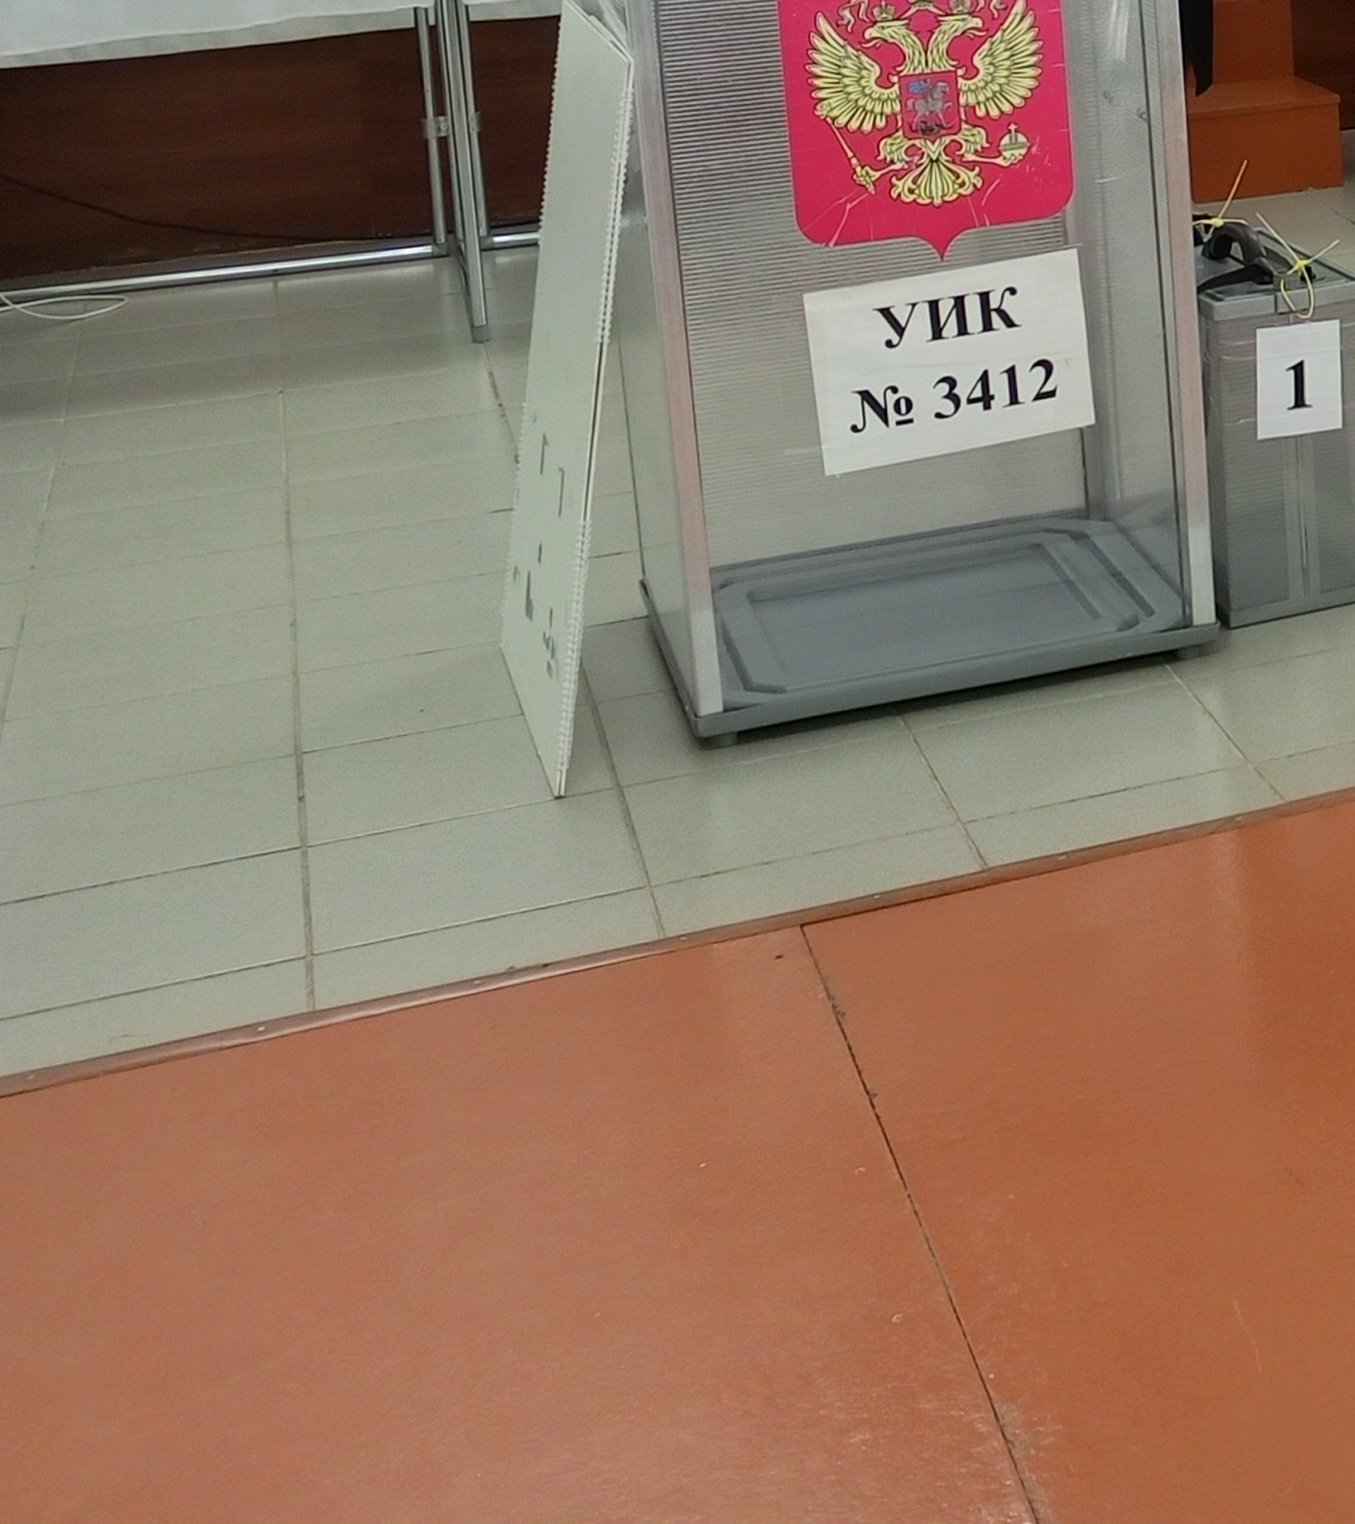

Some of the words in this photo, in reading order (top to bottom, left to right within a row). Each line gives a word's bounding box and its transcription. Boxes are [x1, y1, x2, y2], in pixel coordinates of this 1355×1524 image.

[872, 286, 1023, 349] УИК
[849, 385, 915, 434] №
[932, 358, 1059, 420] 3412
[1285, 359, 1314, 411] 1
